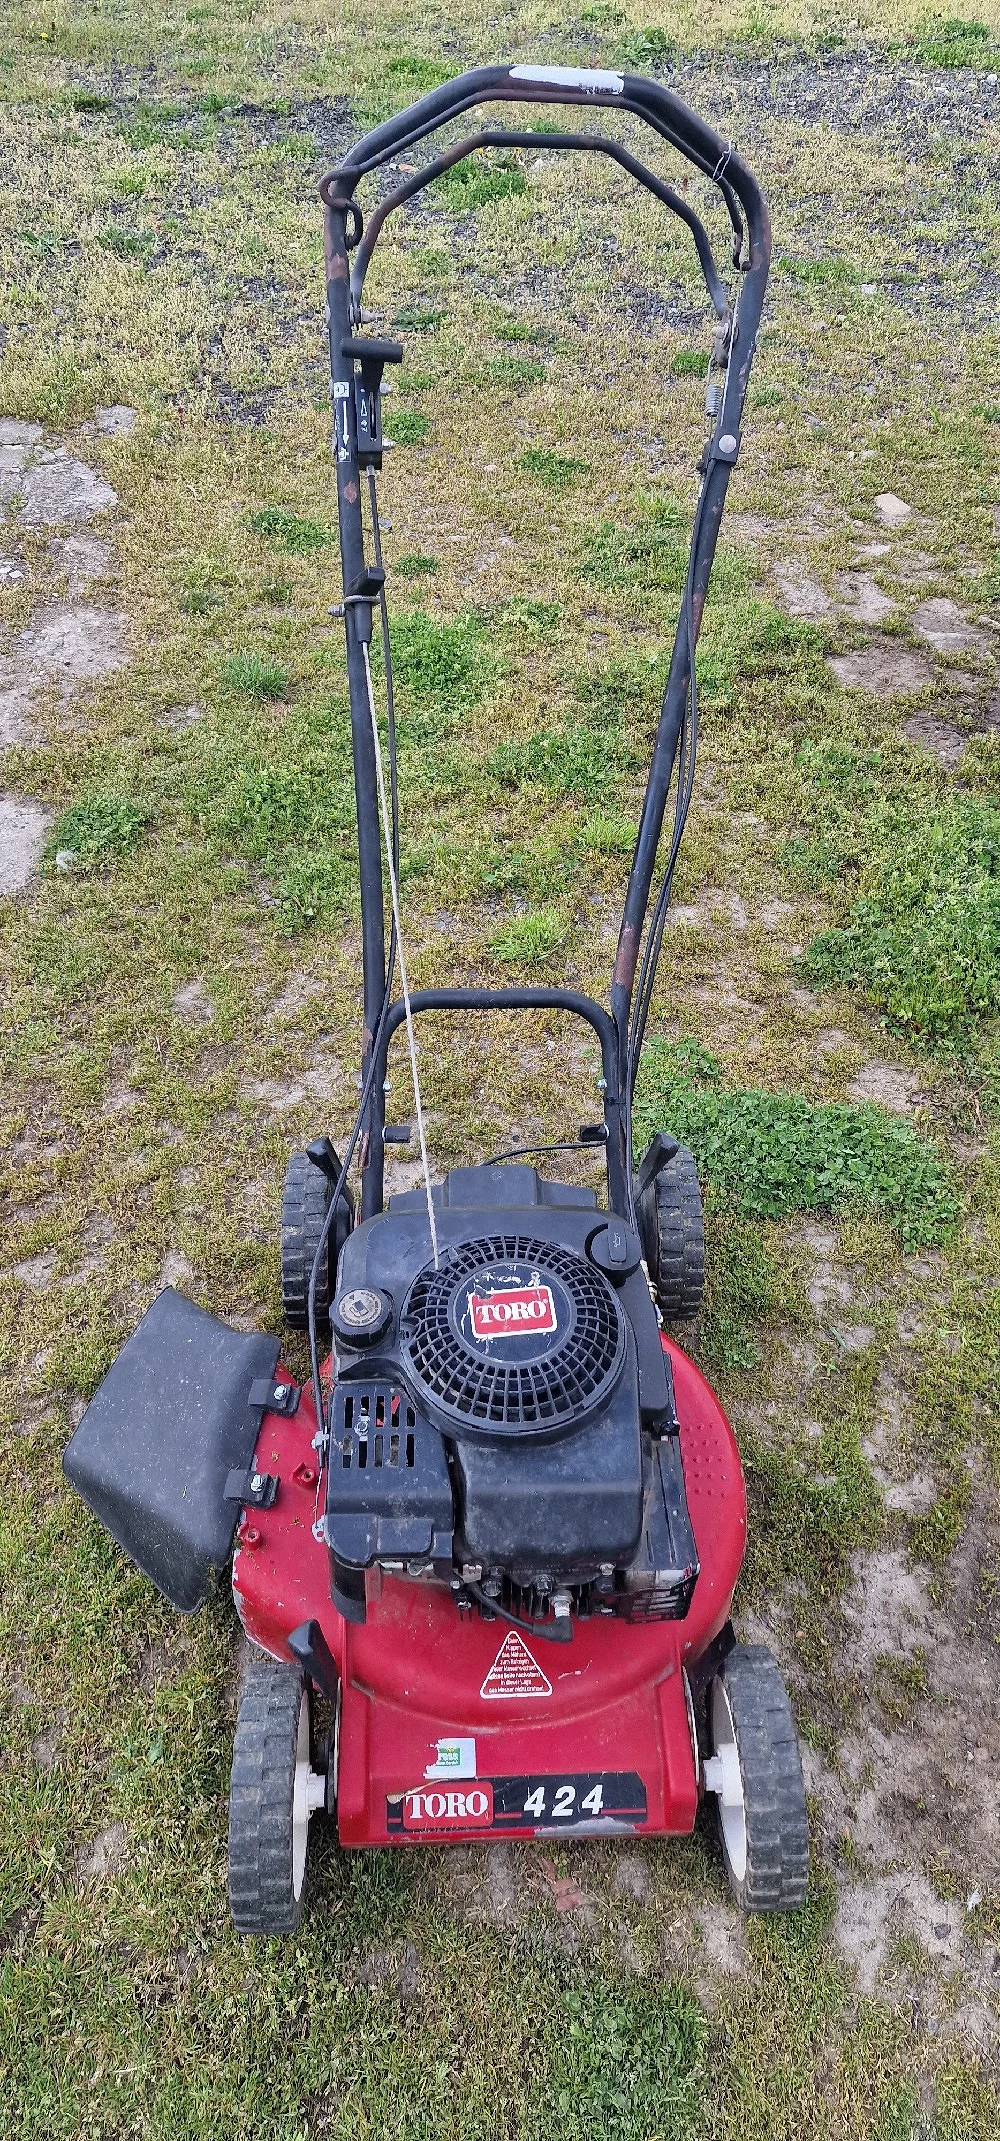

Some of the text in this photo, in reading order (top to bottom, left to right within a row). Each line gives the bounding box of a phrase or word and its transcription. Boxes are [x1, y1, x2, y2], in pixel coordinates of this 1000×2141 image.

[476, 1300, 547, 1324] TORO
[406, 1785, 604, 1819] TORO 424
